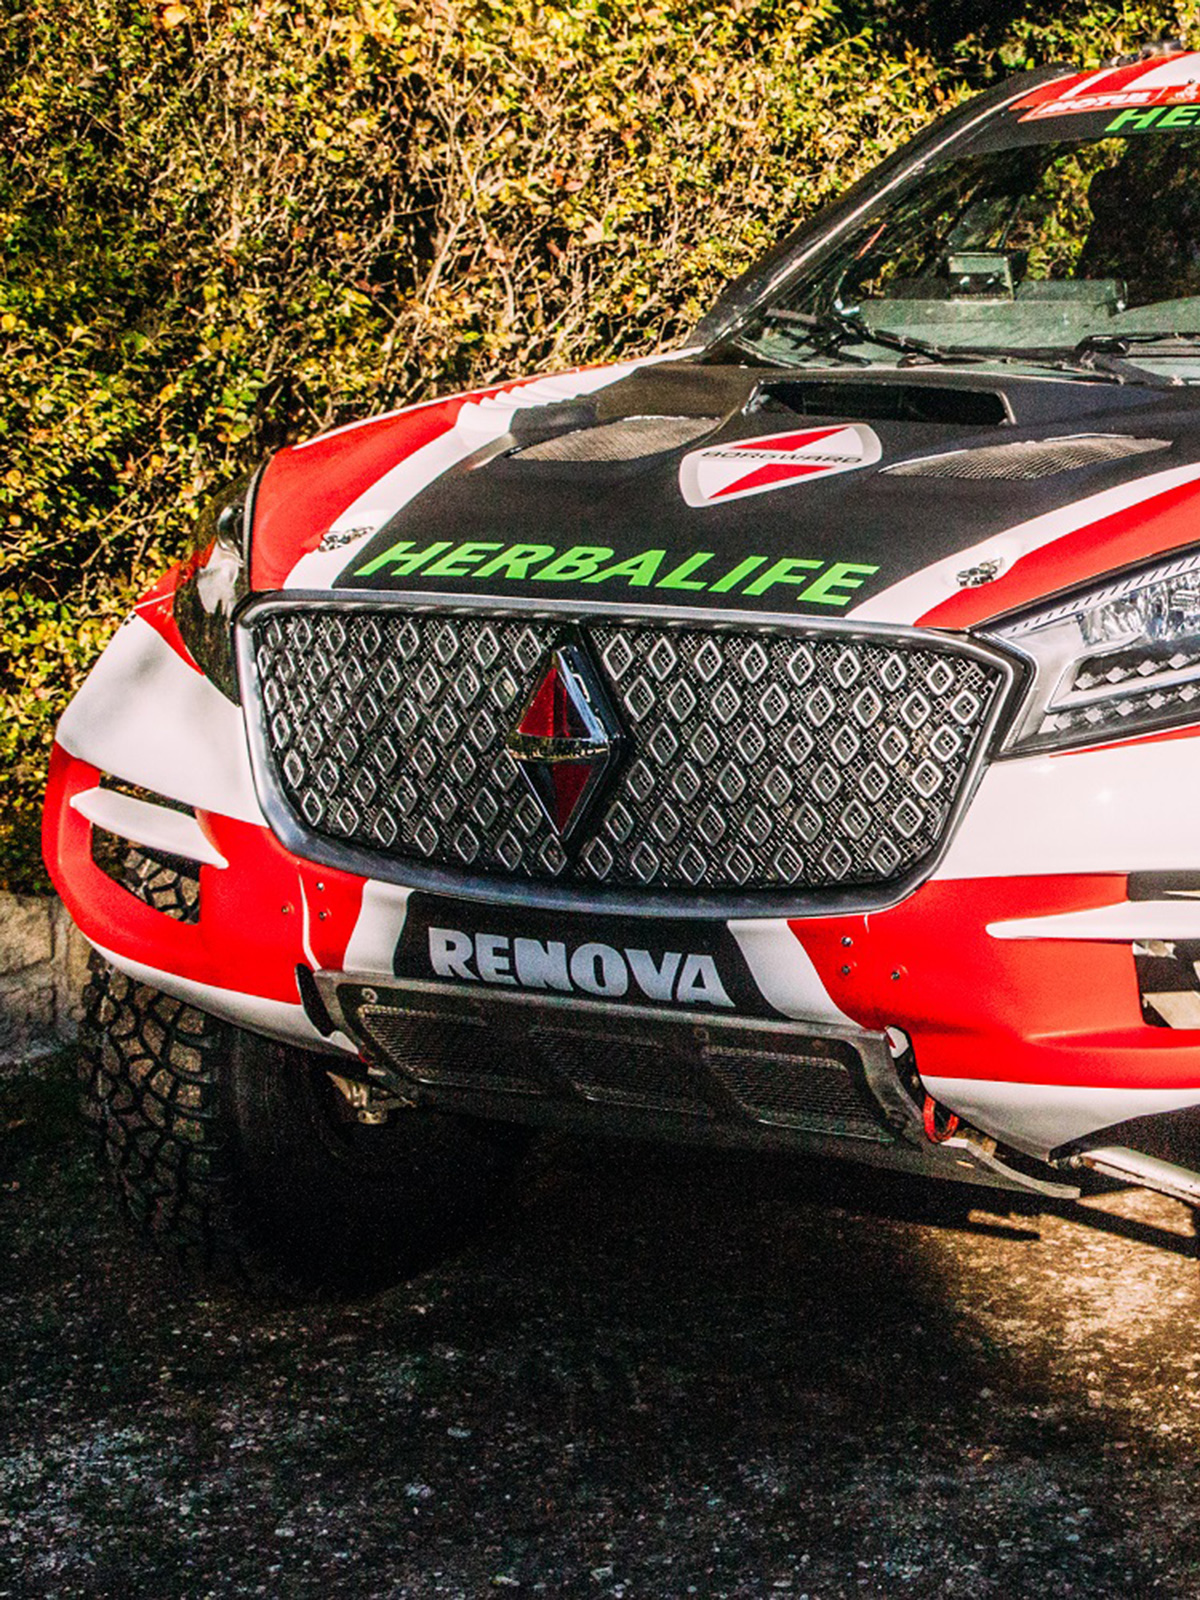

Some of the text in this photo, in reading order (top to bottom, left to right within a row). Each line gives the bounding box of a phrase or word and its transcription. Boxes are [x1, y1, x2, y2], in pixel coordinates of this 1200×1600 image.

[1037, 92, 1151, 114] MOTUL
[702, 451, 863, 464] BORGWARD
[354, 541, 881, 606] HERBALIFE
[428, 927, 737, 1008] RENOVA
